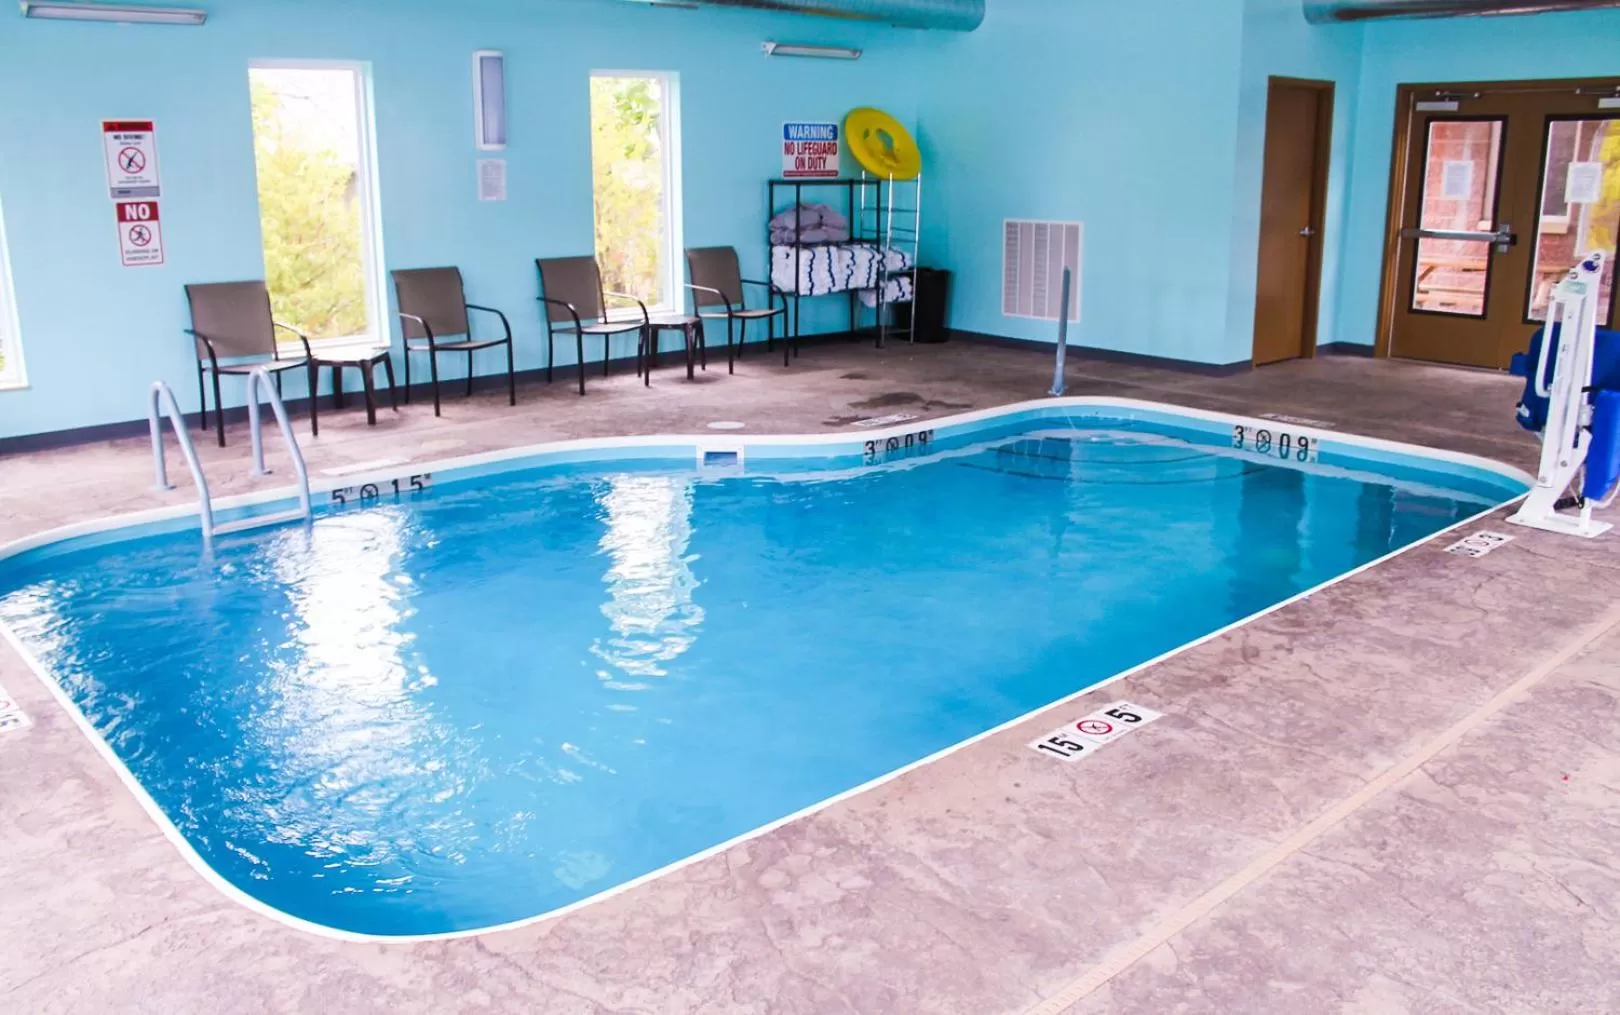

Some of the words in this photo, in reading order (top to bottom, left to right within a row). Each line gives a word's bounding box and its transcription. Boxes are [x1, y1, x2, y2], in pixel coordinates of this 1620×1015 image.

[788, 125, 833, 139] WARNING
[784, 141, 795, 155] NO
[797, 141, 837, 155] LIFEGUARD
[795, 156, 806, 169] ON
[808, 156, 826, 169] DUTY
[125, 203, 150, 220] NO
[1104, 708, 1142, 723] 5
[1037, 736, 1084, 757] 15
